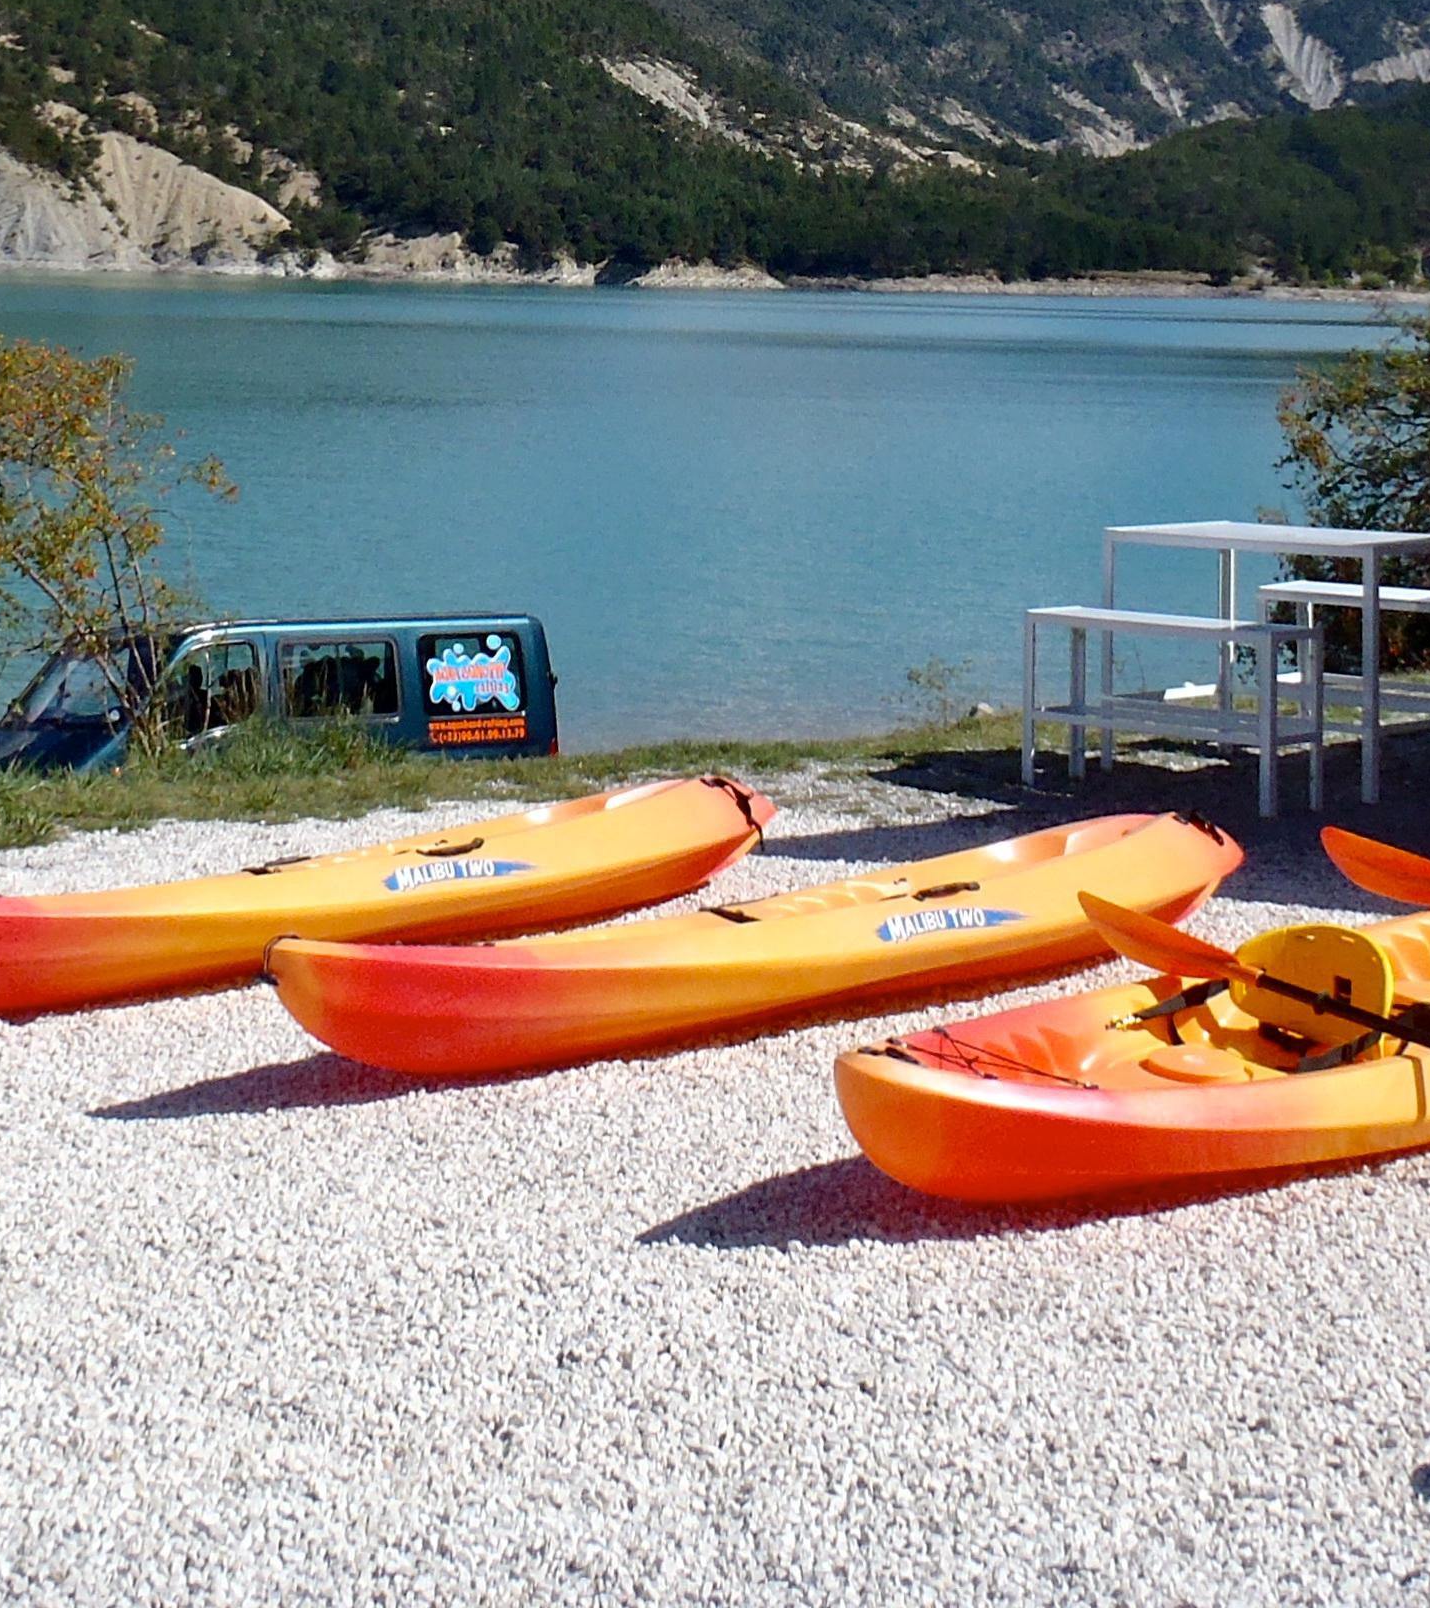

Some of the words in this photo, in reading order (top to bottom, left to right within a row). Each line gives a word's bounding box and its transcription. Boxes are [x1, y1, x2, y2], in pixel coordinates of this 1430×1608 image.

[394, 860, 456, 891] MALIBU
[457, 859, 496, 877] TWO
[886, 909, 947, 942] MALIBU
[948, 907, 986, 928] TWO
